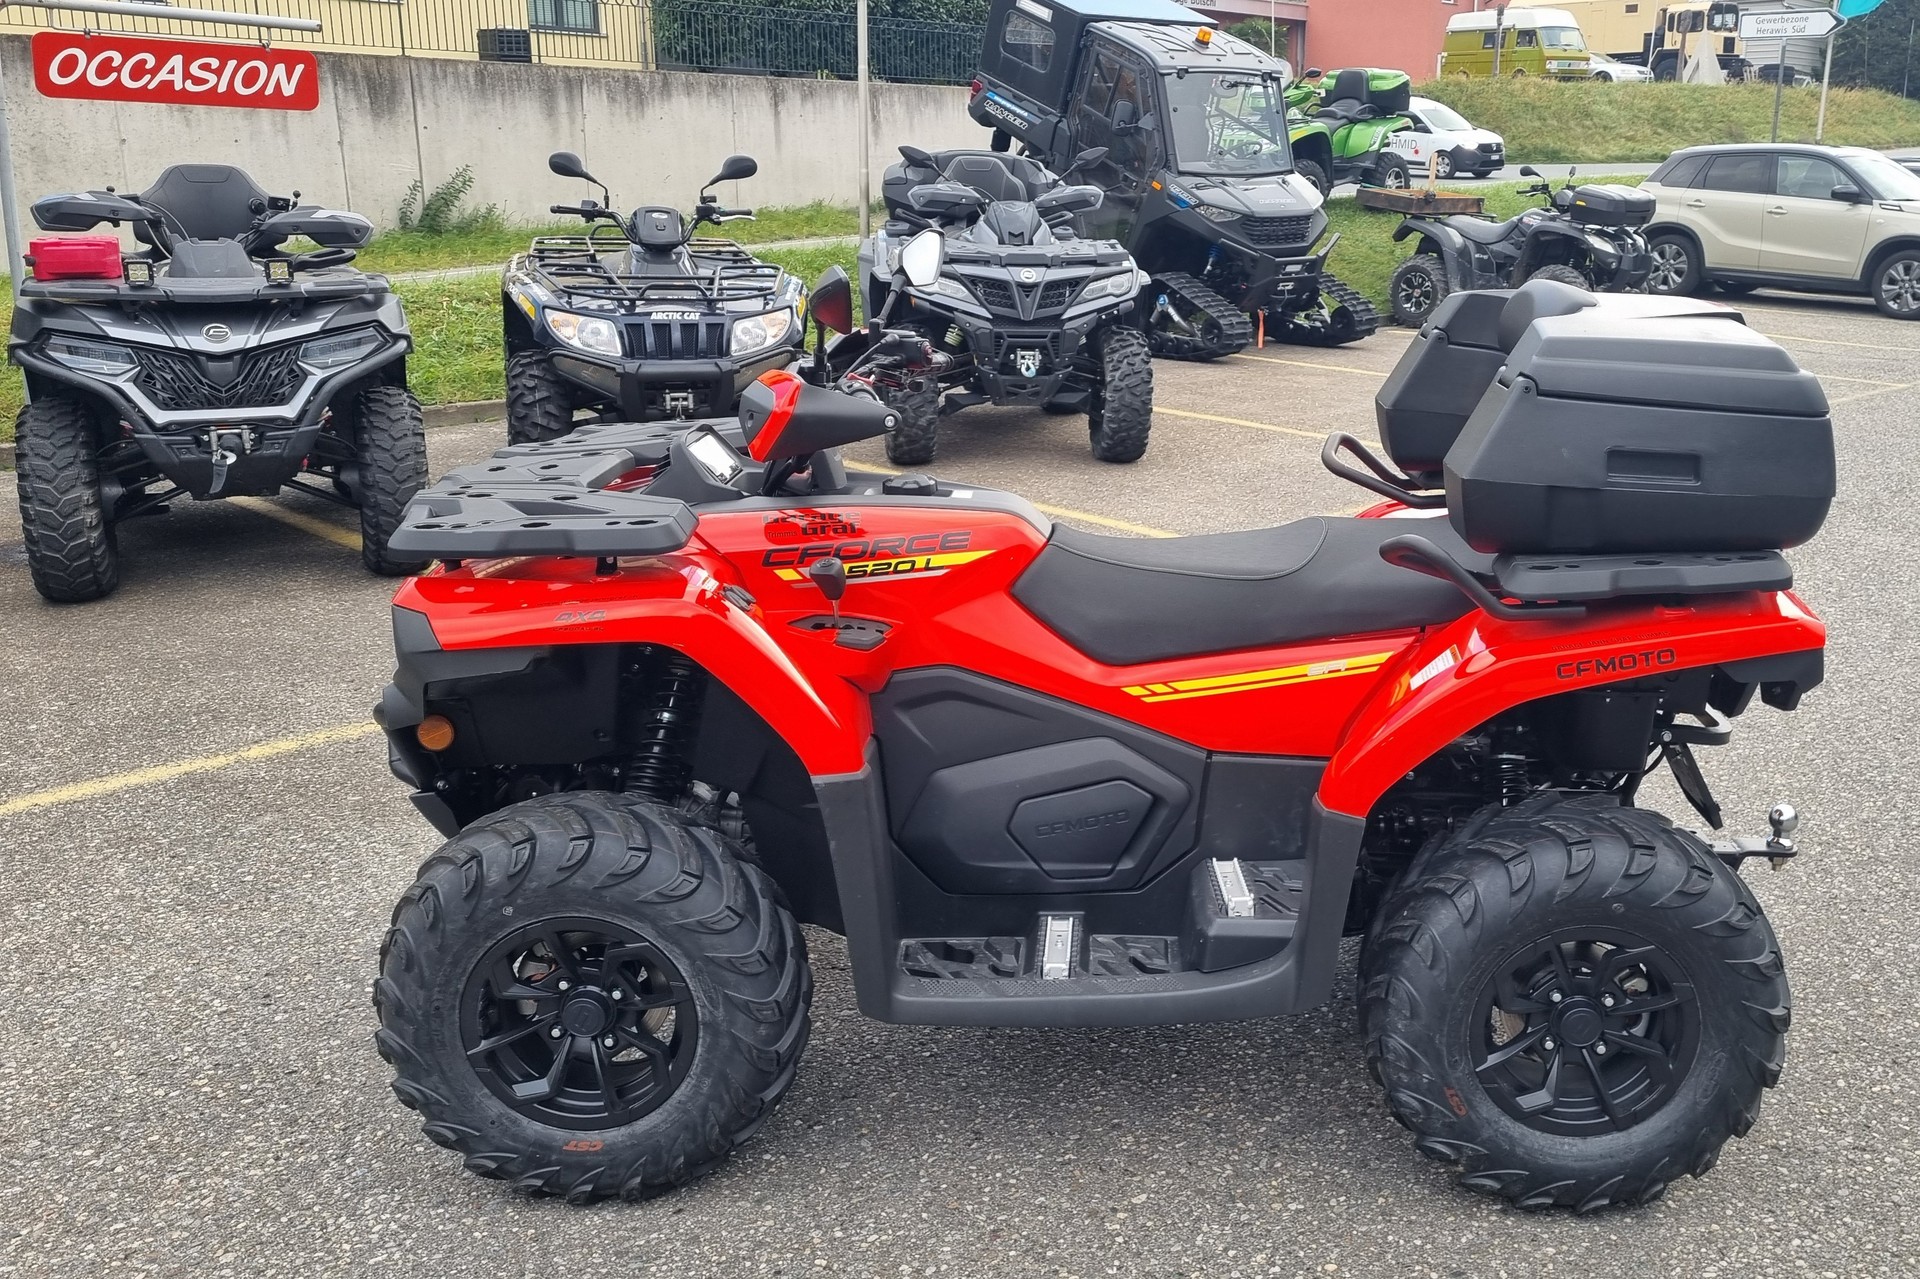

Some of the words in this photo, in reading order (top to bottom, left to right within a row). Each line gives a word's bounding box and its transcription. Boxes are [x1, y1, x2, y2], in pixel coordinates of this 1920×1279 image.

[1755, 15, 1810, 25] Gewerbezone
[1756, 26, 1788, 35] Herawis
[1791, 25, 1806, 34] Süd
[48, 47, 305, 97] OCCASION
[984, 99, 1029, 130] RANGER
[1391, 138, 1418, 150] HMID
[650, 311, 682, 320] ARCTIC
[683, 311, 701, 320] CAT
[761, 531, 972, 568] CFORCE
[846, 559, 917, 580] 520
[1556, 648, 1677, 680] CFMOTO
[1034, 809, 1130, 838] CFMOTO
